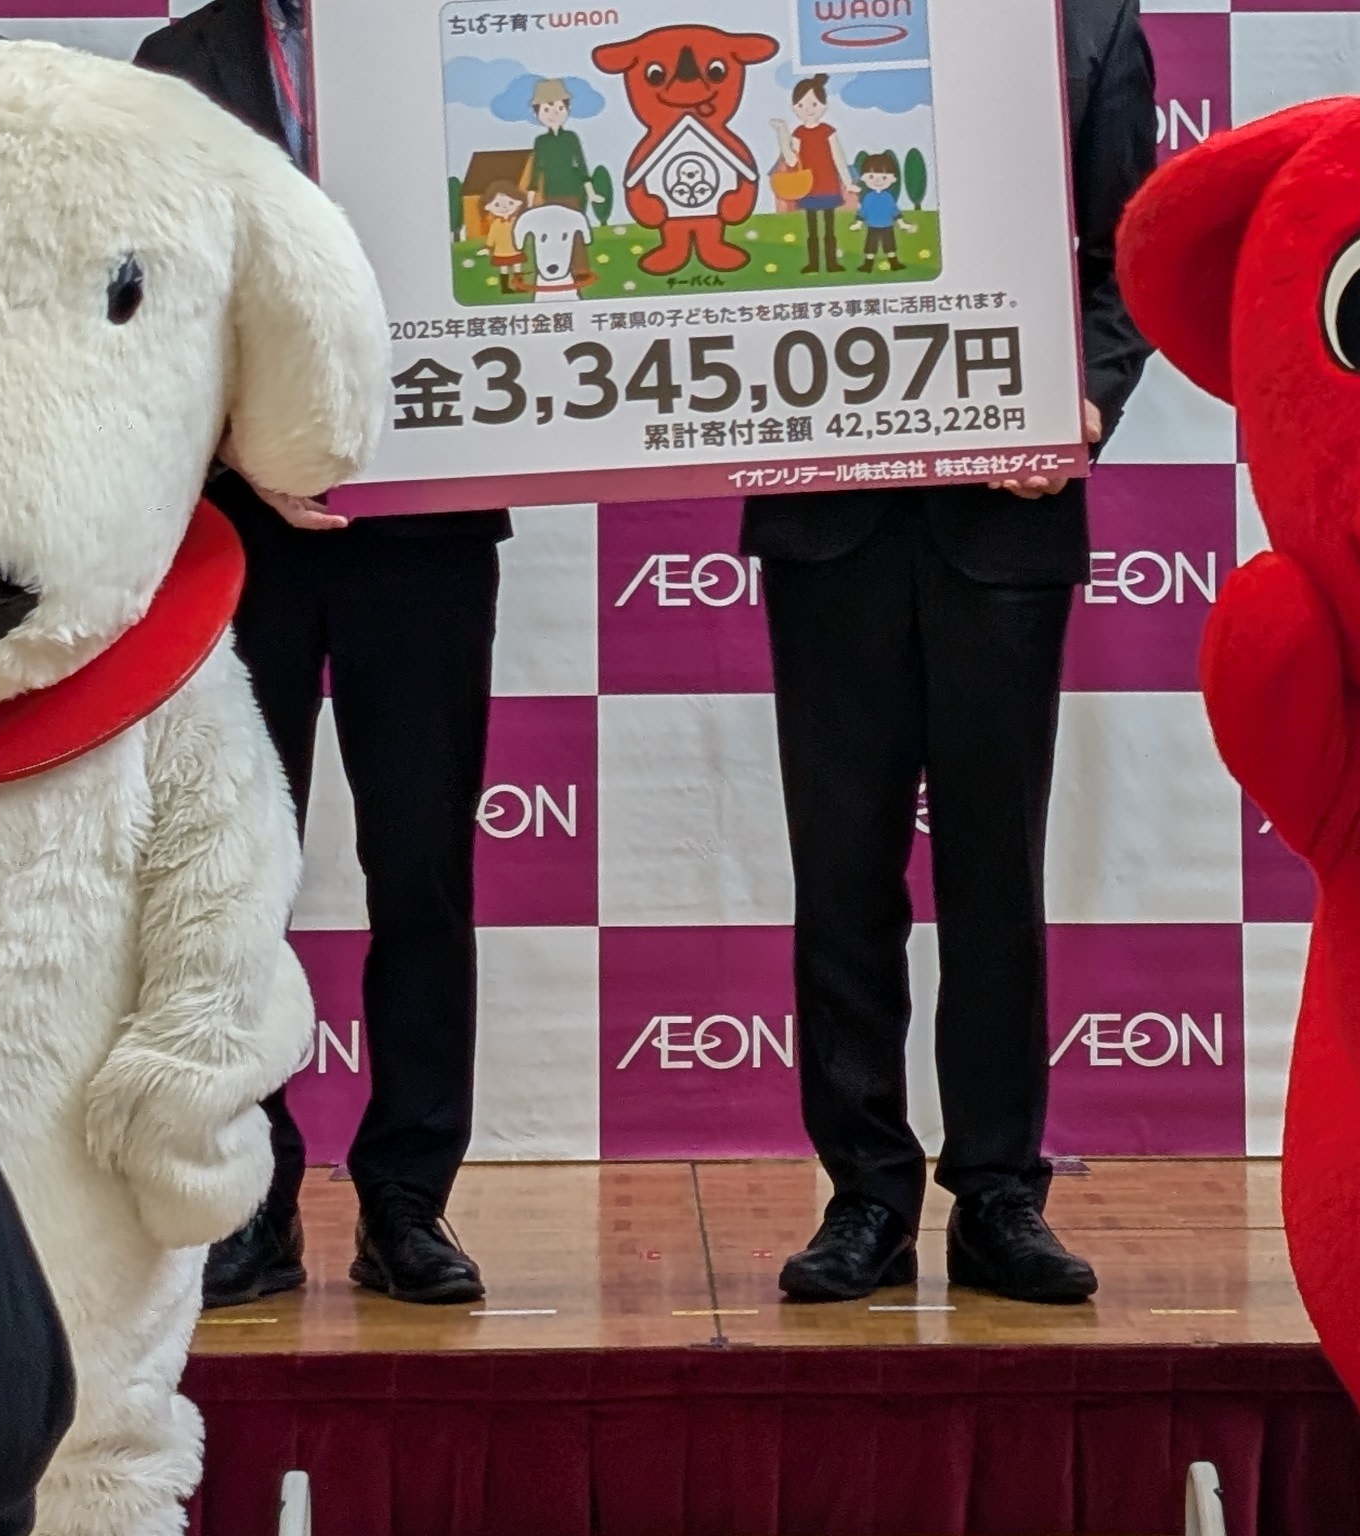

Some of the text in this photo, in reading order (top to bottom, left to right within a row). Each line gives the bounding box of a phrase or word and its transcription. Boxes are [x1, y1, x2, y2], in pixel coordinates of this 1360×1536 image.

[390, 291, 1019, 341] 2025年度寄付金額 千葉県の子どもたちを応援する事業に活用されます。
[391, 324, 1024, 431] 金3,345,097円
[644, 406, 1026, 450] 累計寄付金額 42,523,228円
[728, 453, 1076, 489] イオンリテール株式会社 株式会社ダイエー
